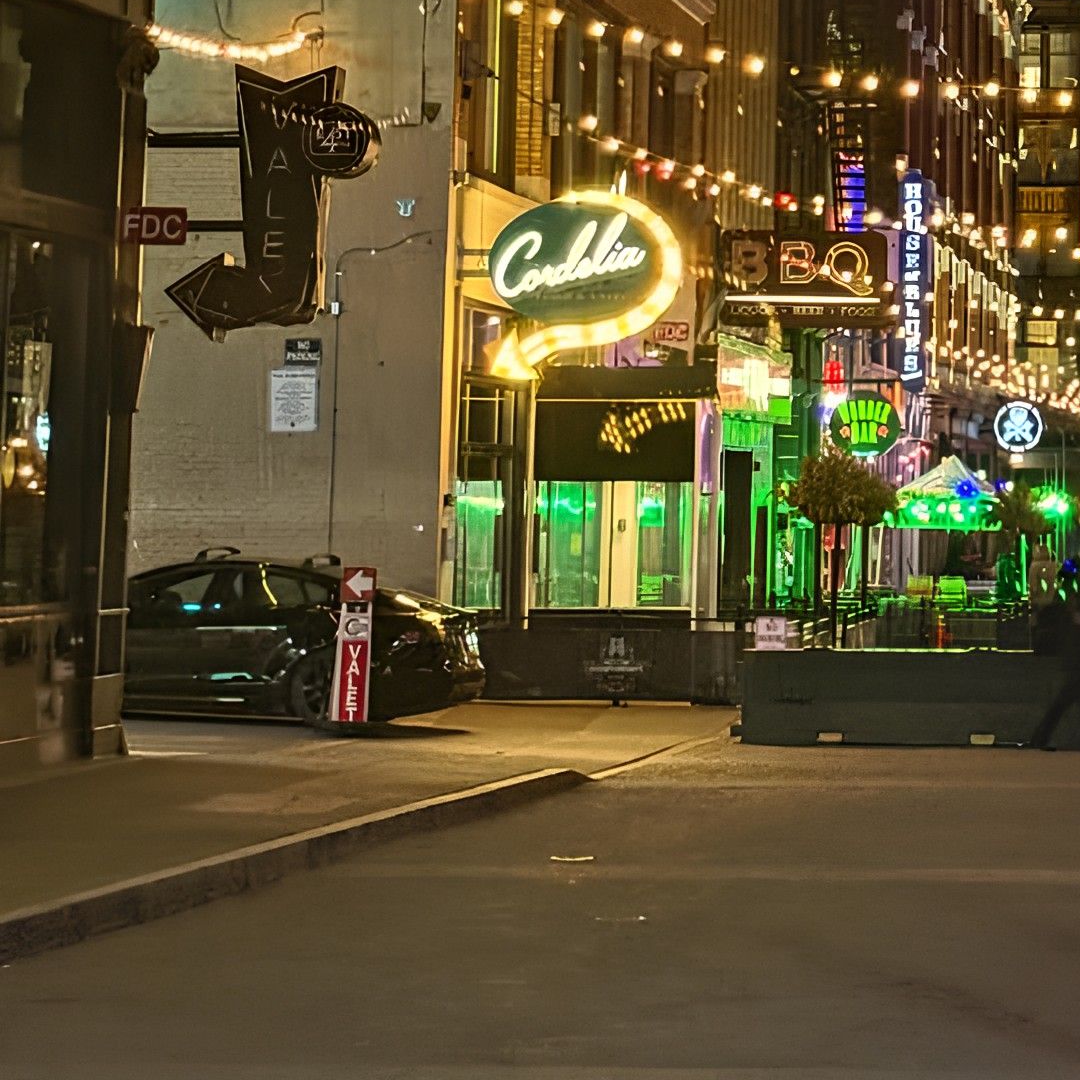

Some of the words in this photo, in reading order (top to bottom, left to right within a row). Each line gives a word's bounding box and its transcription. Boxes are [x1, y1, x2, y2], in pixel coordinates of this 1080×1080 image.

[123, 214, 182, 239] FDC
[494, 211, 647, 299] Cordelia
[346, 644, 362, 721] VALET
